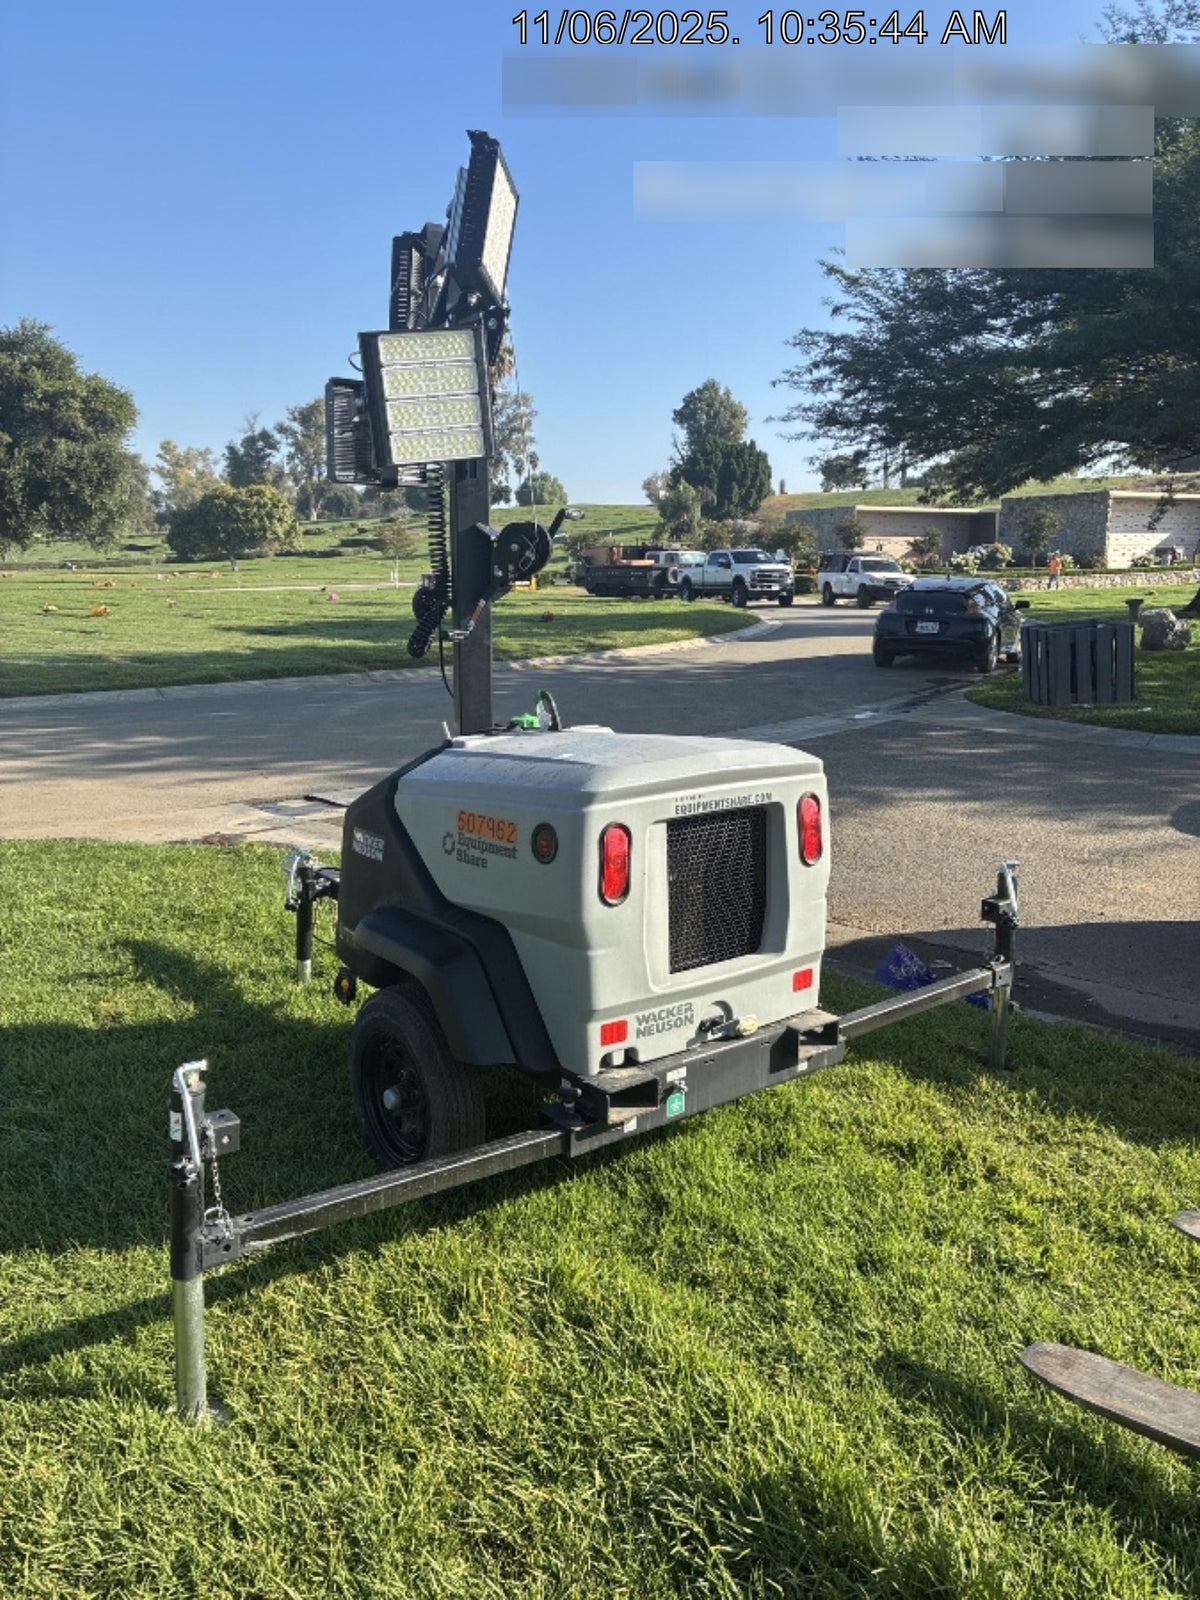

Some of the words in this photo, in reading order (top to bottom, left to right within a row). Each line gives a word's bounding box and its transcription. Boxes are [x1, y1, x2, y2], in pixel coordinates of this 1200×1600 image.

[457, 831, 518, 859] Equipment
[456, 848, 488, 868] Share
[635, 1002, 694, 1026] WACKER
[636, 1013, 694, 1039] NEUSON
